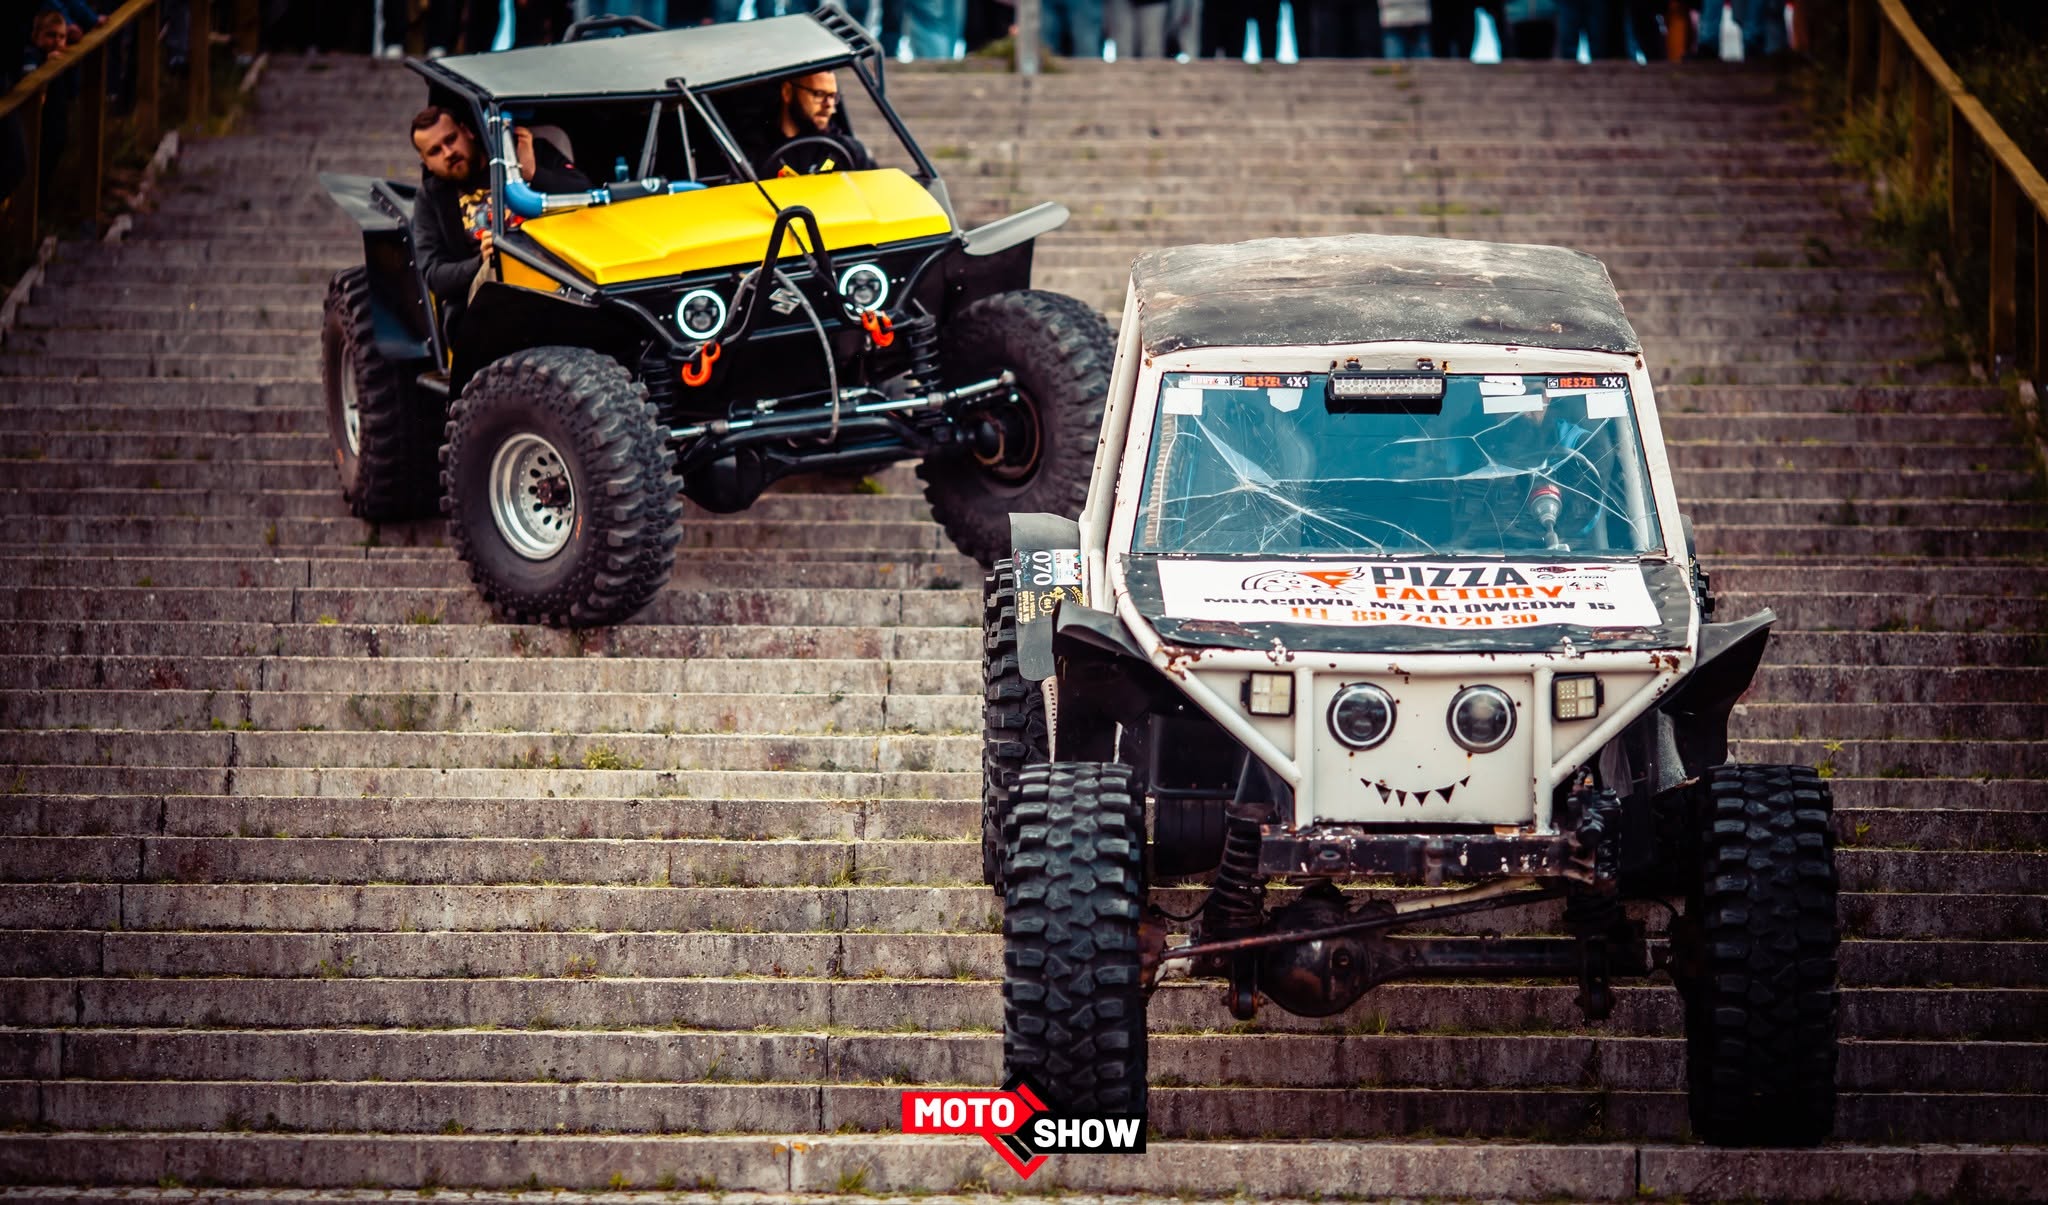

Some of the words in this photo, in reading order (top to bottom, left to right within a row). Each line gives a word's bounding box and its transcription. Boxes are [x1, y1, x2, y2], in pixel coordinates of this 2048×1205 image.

[1243, 376, 1284, 388] RESZEL
[1559, 376, 1599, 389] RESZEL
[1032, 551, 1053, 586] 070
[1370, 566, 1530, 587] PIZZA
[1375, 585, 1565, 602] FACTORY
[1586, 601, 1616, 611] 15
[1351, 609, 1389, 622] 89
[1398, 612, 1448, 626] 741
[1456, 615, 1494, 627] 20
[1501, 613, 1540, 625] 30
